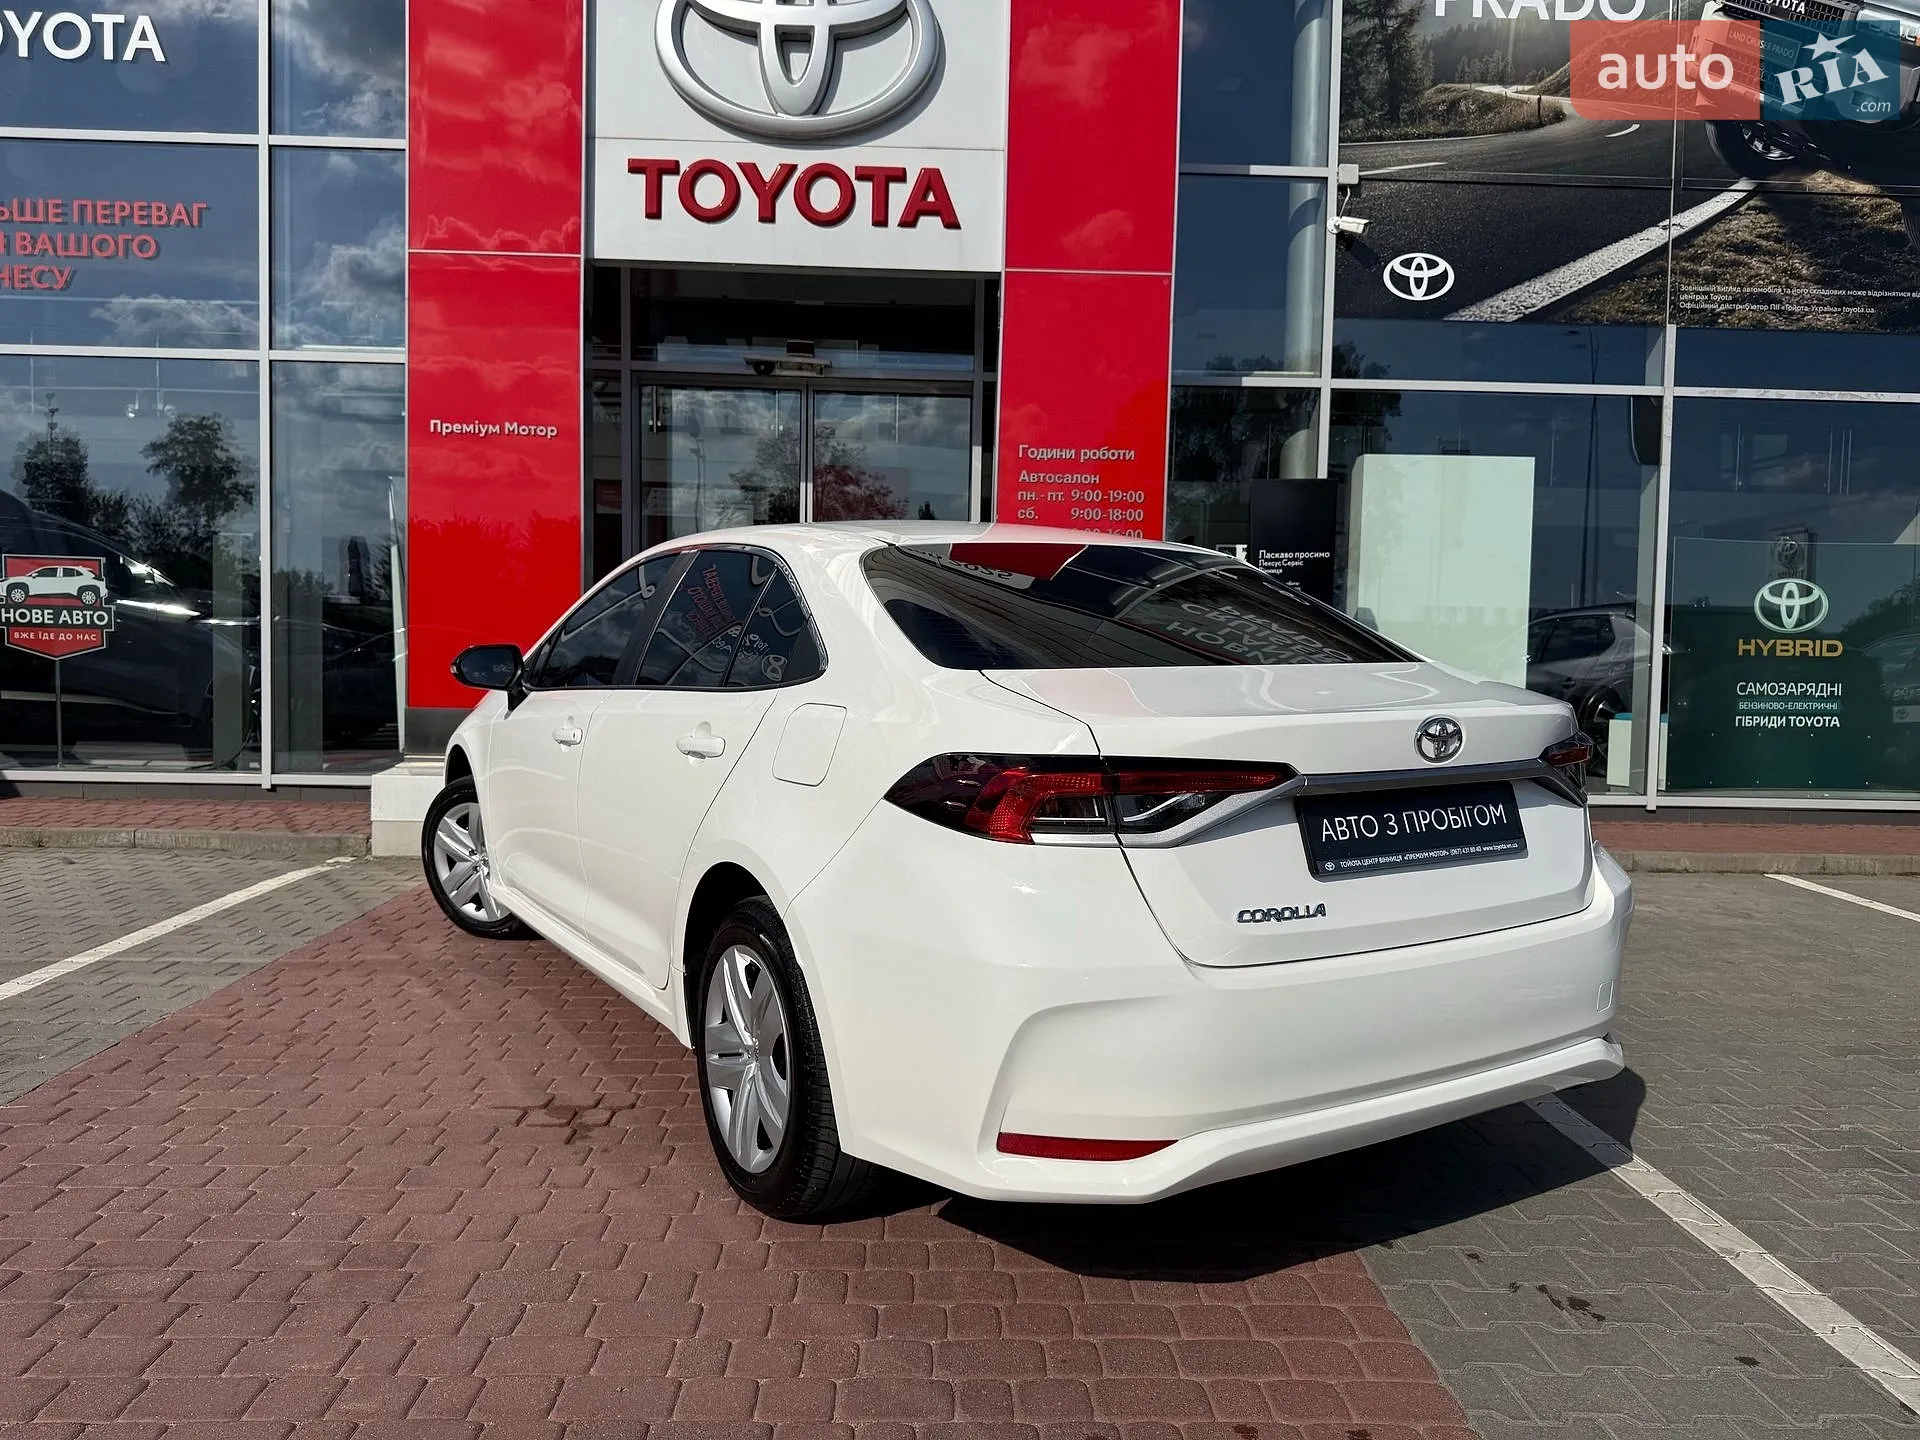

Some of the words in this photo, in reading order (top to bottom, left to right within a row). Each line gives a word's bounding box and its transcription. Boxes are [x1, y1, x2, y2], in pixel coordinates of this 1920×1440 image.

[0, 10, 166, 62] YOTA
[628, 158, 962, 230] TOYOTA
[72, 199, 208, 227] ПЕРЕВАГ
[15, 231, 157, 259] ВАШОГО
[1680, 294, 1709, 302] центрах
[1867, 288, 1911, 298] відрізнятися
[1680, 301, 1719, 310] Офіційний
[1842, 305, 1875, 314] toyota.ua
[430, 419, 501, 437] Преміум
[505, 421, 558, 439] Мотор
[1018, 444, 1076, 461] Години
[1080, 446, 1136, 463] роботи
[1018, 470, 1100, 484] Автосалон
[1017, 507, 1039, 520] сб.
[1294, 551, 1331, 562] просимо
[1, 608, 54, 624] НОВЕ
[58, 610, 109, 626] АВТО
[14, 631, 35, 640] ВЖЕ
[38, 630, 55, 641] ЇДЕ
[58, 632, 73, 641] ДО
[76, 633, 97, 641] НАС
[1738, 638, 1844, 657] HYBRID
[1736, 681, 1842, 698] САМОЗАРЯДНІ
[1738, 701, 1838, 711] БЕНЗИНОВО-ЕЛЕКТРИЧНІ
[1735, 715, 1786, 729] ГІБРИДИ
[1789, 716, 1841, 728] TOYOTA
[1321, 814, 1379, 842] АВТО
[1403, 803, 1508, 834] ПРОБІГОМ
[1339, 859, 1362, 868] ТОЙОТА
[1362, 857, 1379, 866] ЦЕНТР
[1236, 902, 1327, 924] COROLLA
